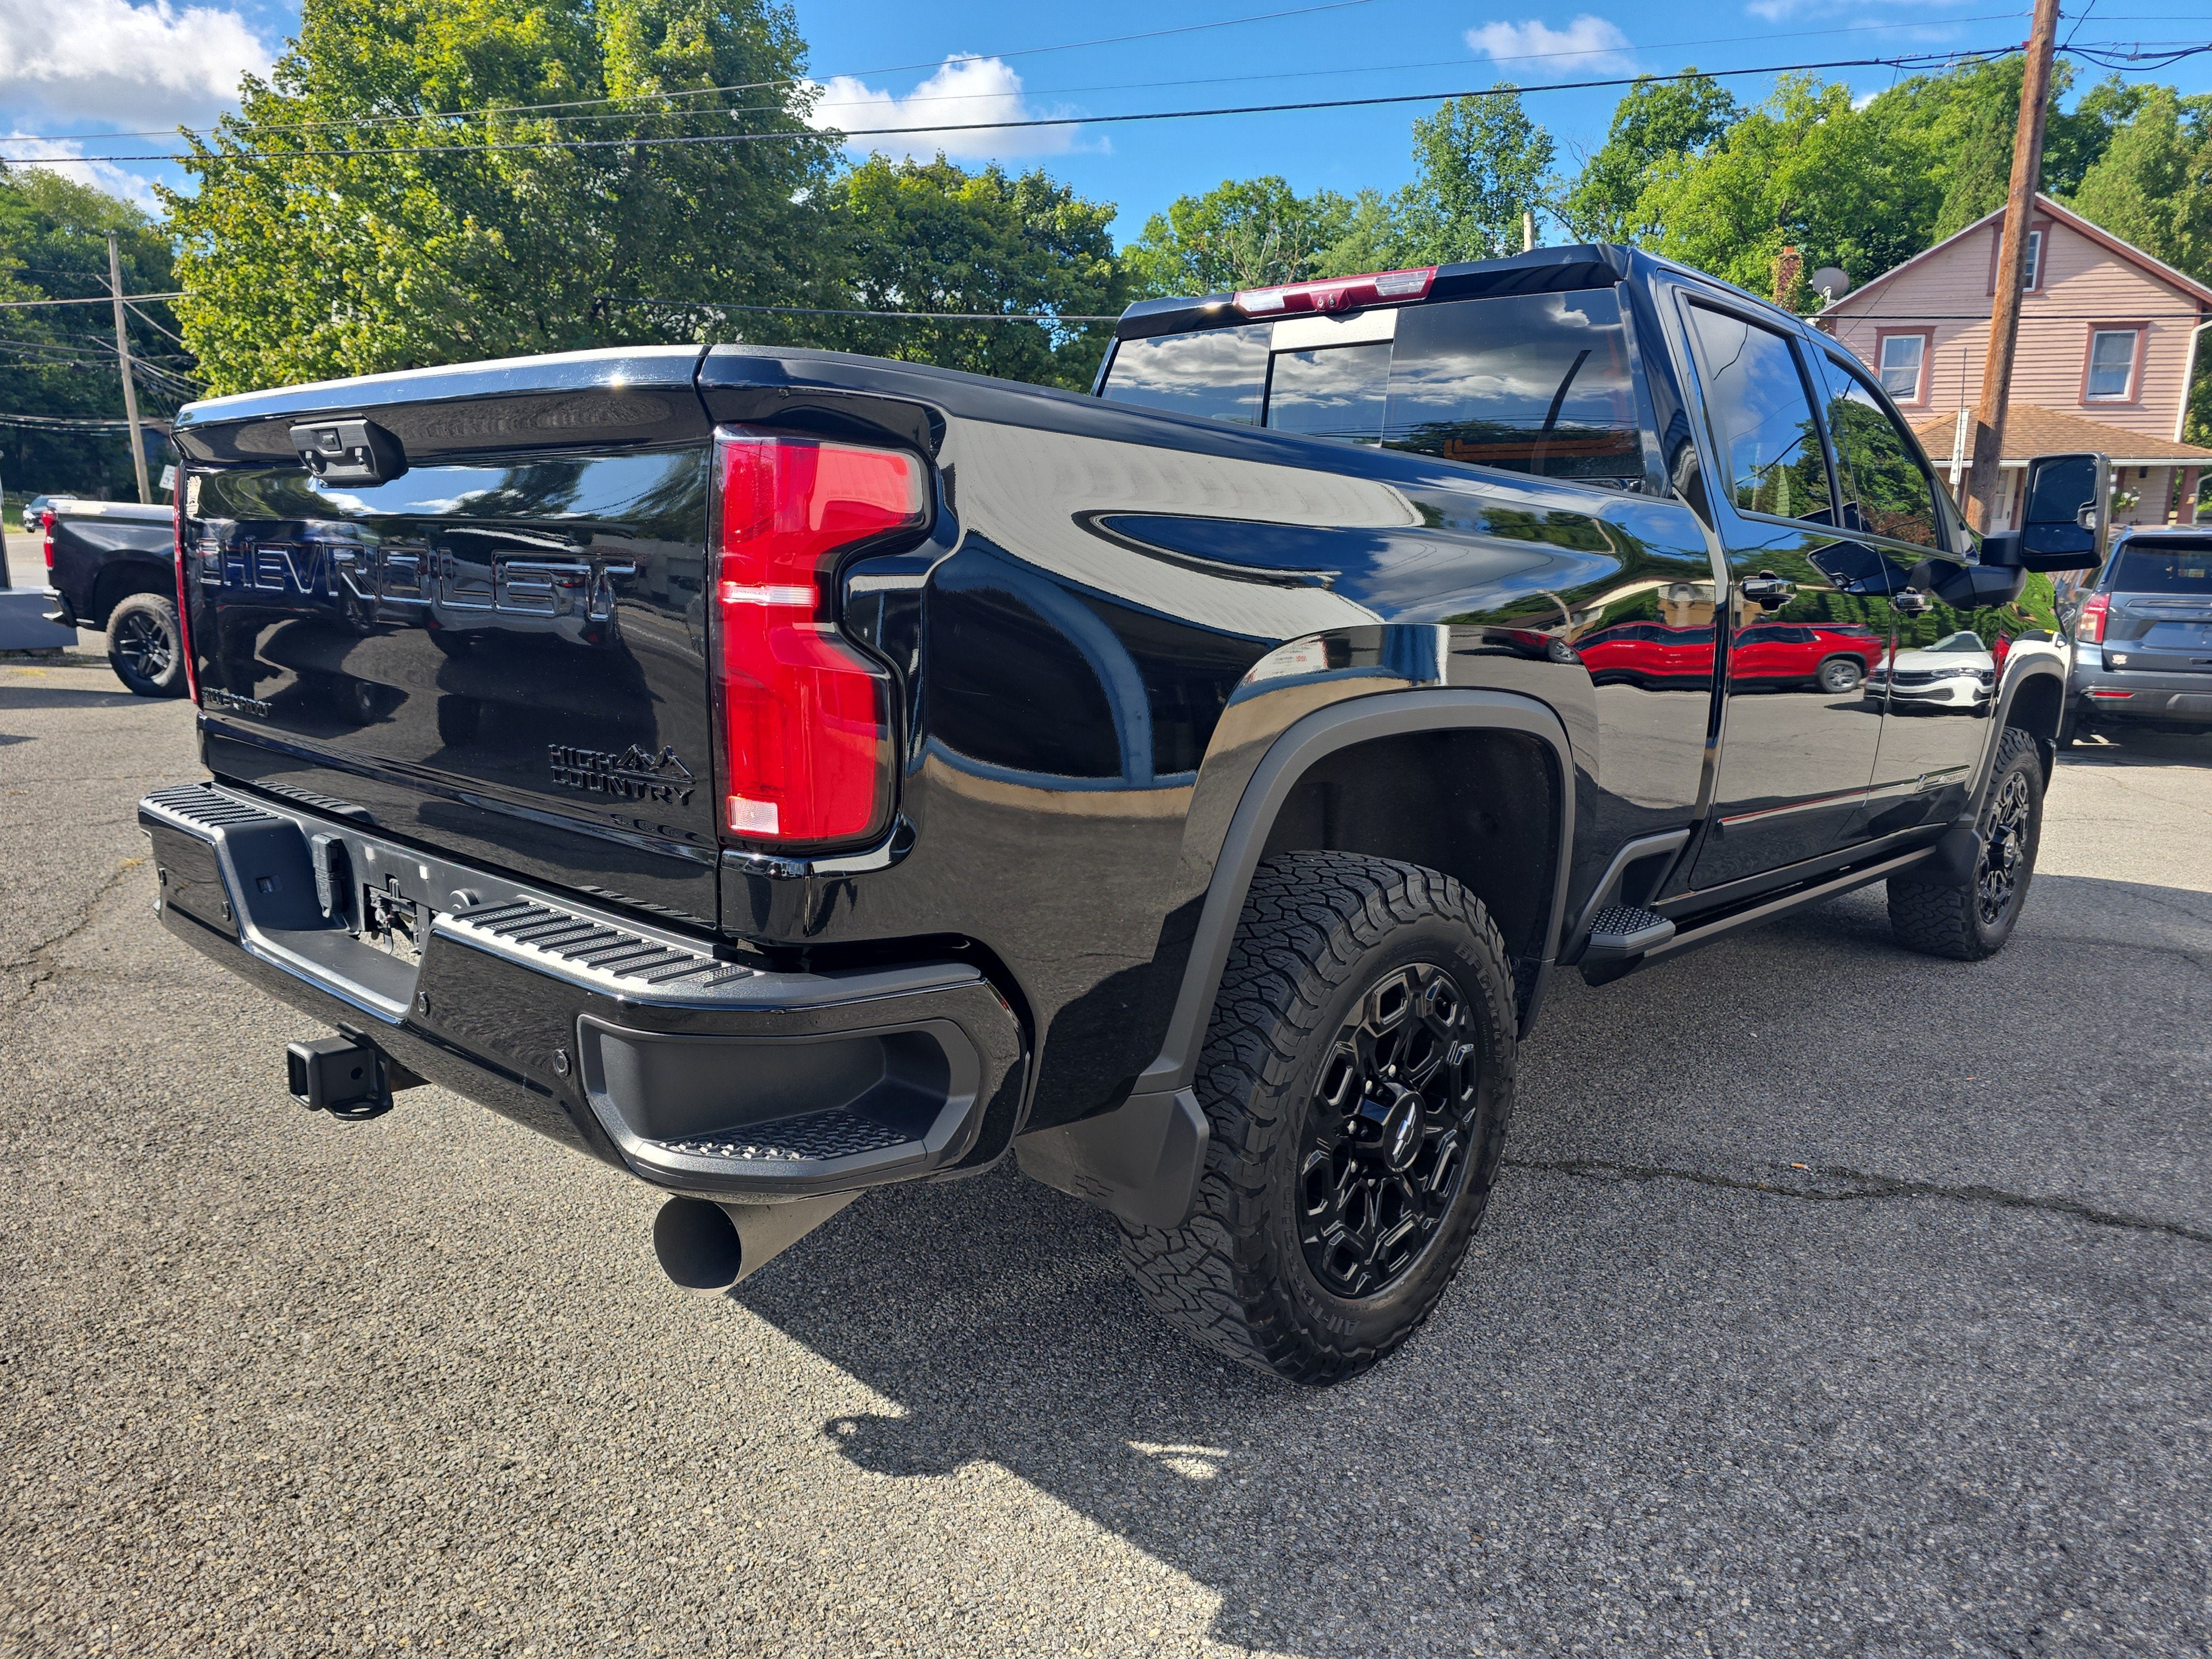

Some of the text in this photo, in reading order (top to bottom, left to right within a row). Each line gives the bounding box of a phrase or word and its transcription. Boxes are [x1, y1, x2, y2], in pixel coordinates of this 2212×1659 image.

[196, 537, 636, 622] CHEVROLET
[548, 743, 617, 772] HIGH
[550, 765, 696, 806] COUNTRY
